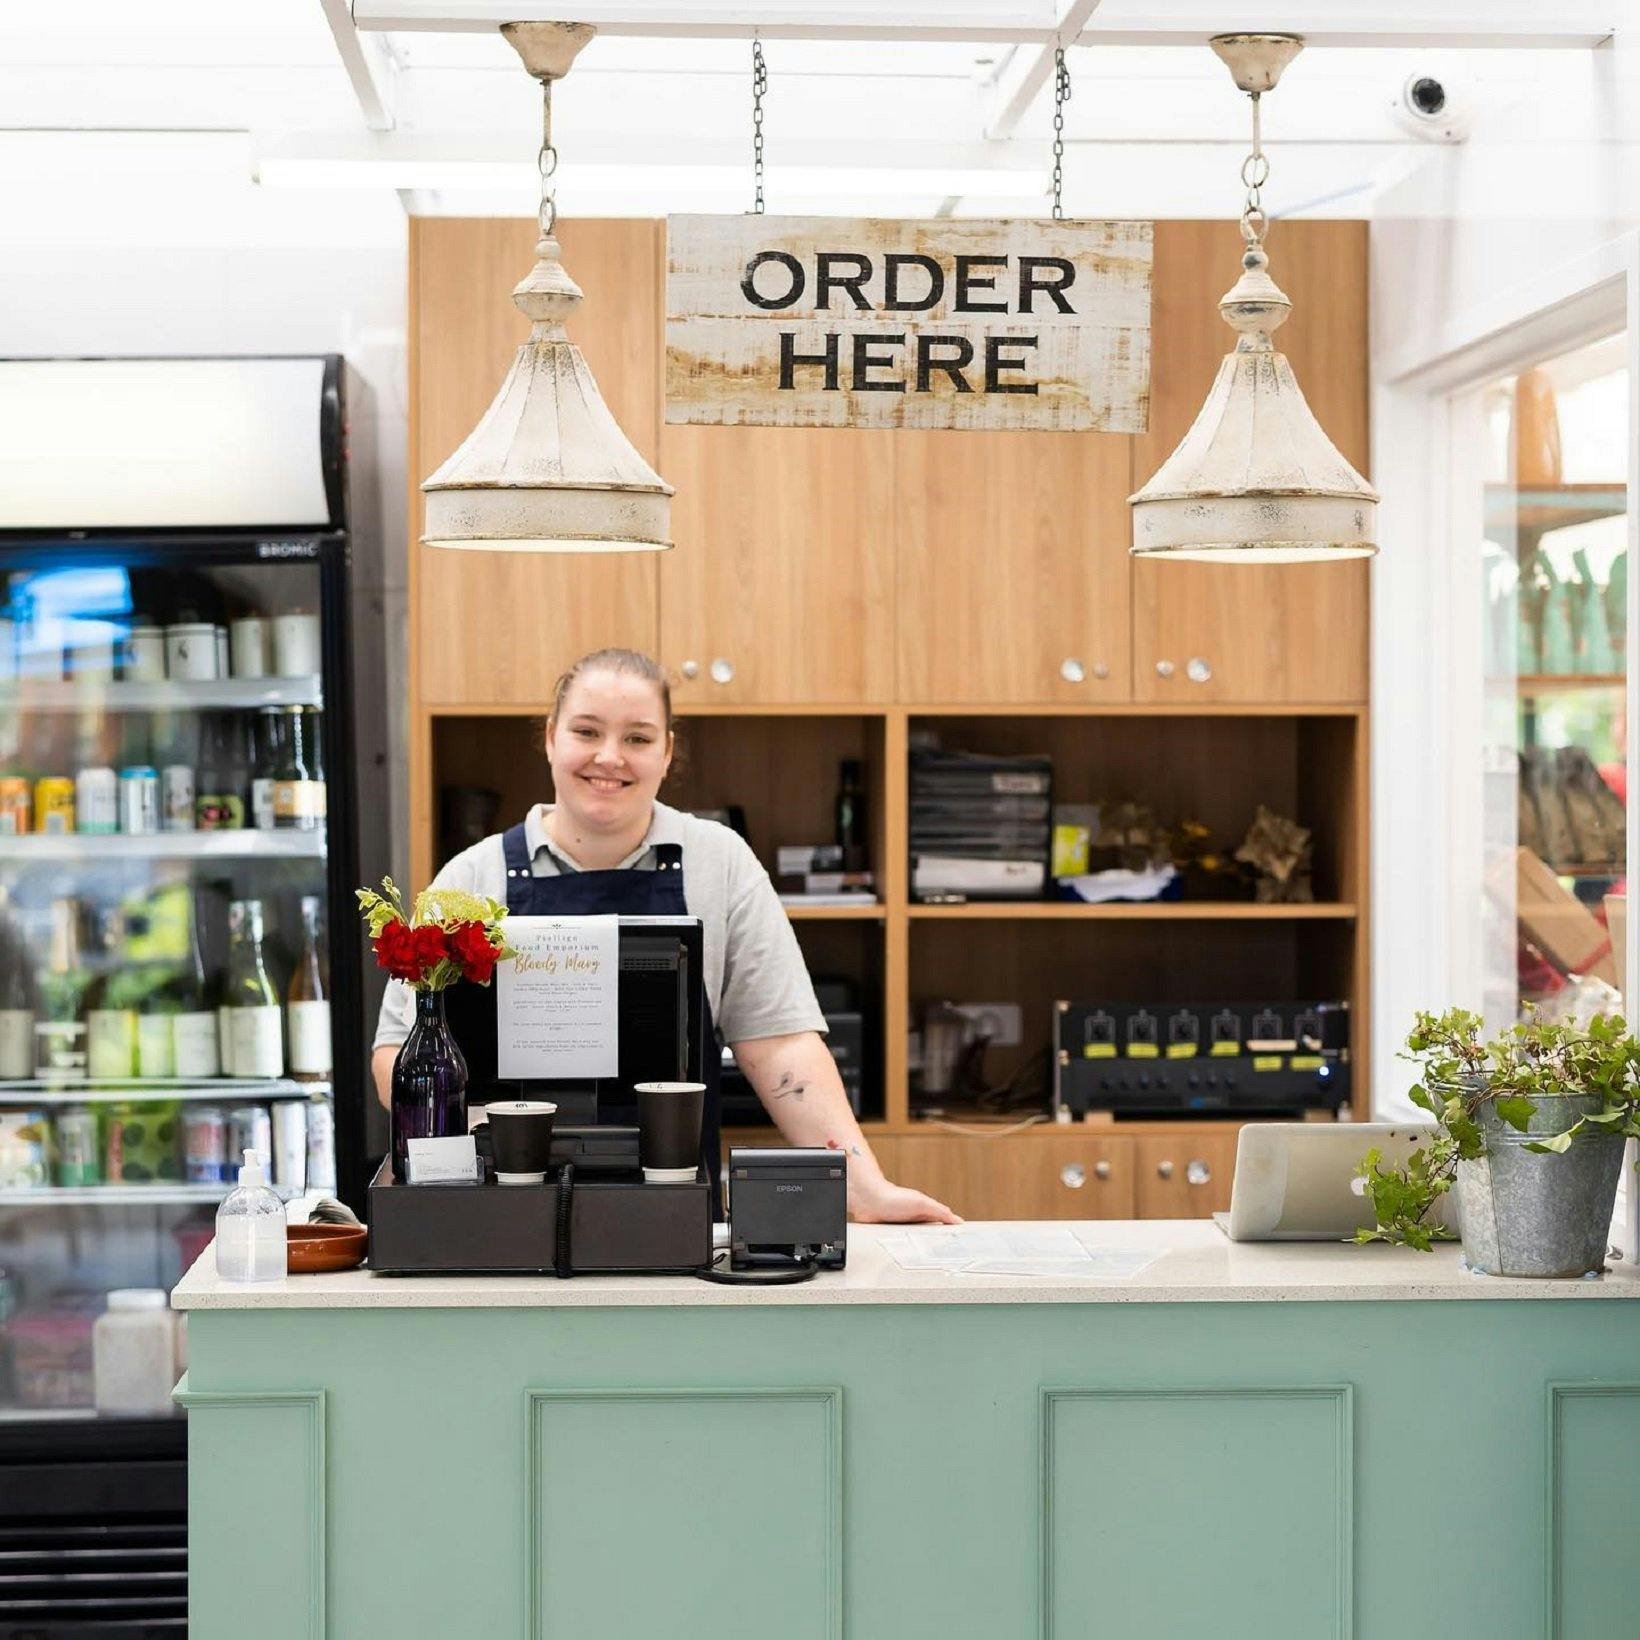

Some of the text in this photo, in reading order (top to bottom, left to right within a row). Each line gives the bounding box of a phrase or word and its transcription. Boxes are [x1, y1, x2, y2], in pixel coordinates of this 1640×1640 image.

[740, 250, 1077, 315] ORDER
[778, 332, 1039, 396] HERE
[514, 952, 600, 975] Bloody Mary
[546, 944, 599, 952] Emporium
